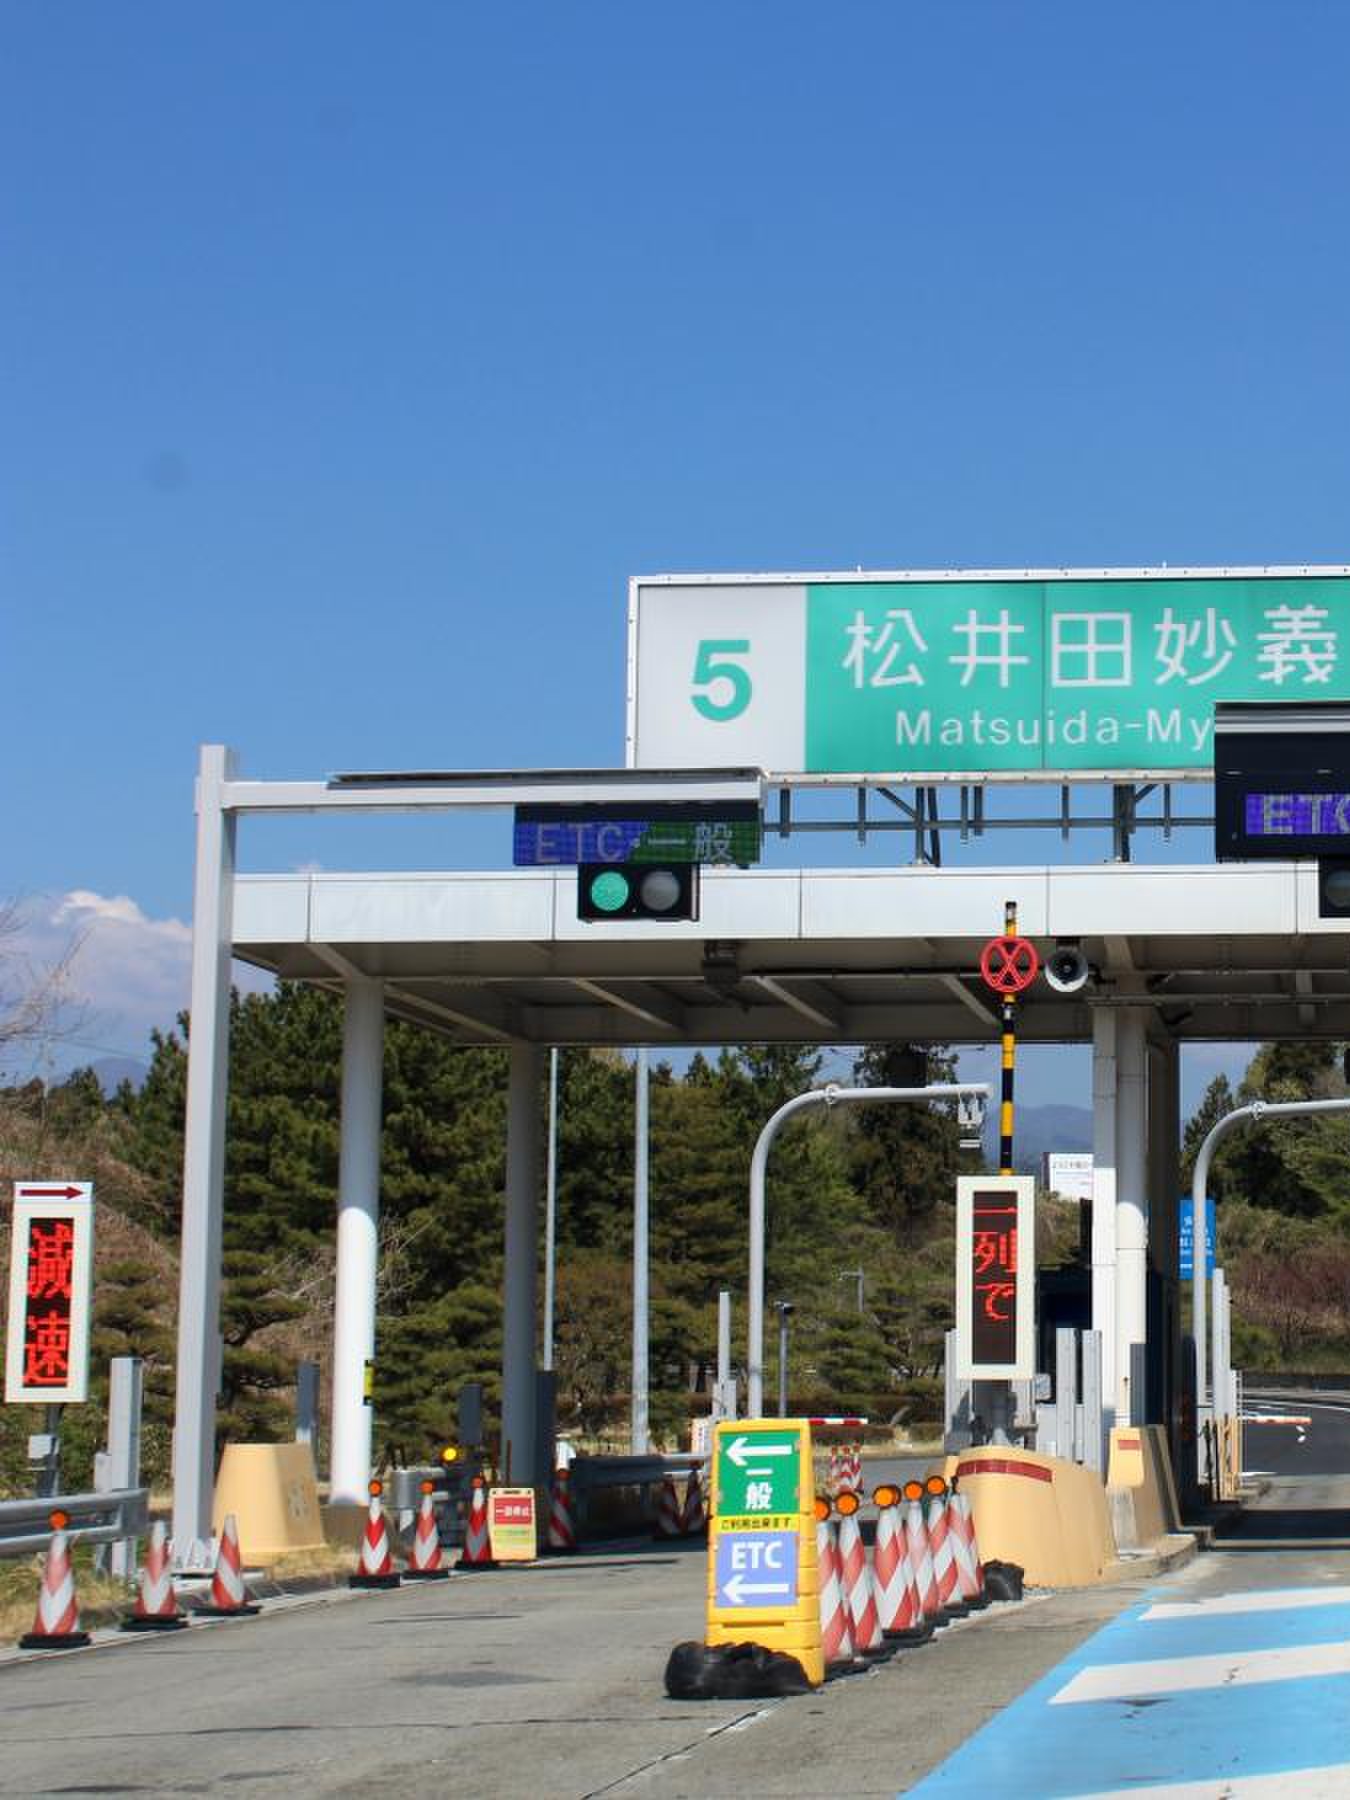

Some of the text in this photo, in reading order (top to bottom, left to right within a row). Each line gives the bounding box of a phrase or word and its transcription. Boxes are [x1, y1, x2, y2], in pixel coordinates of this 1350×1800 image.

[690, 639, 752, 722] 5
[842, 603, 1339, 689] 松井田妙義
[24, 1221, 74, 1384] 減速
[972, 1207, 1018, 1321] 一列で
[745, 1468, 773, 1510] 一般
[731, 1541, 783, 1569] ETC
